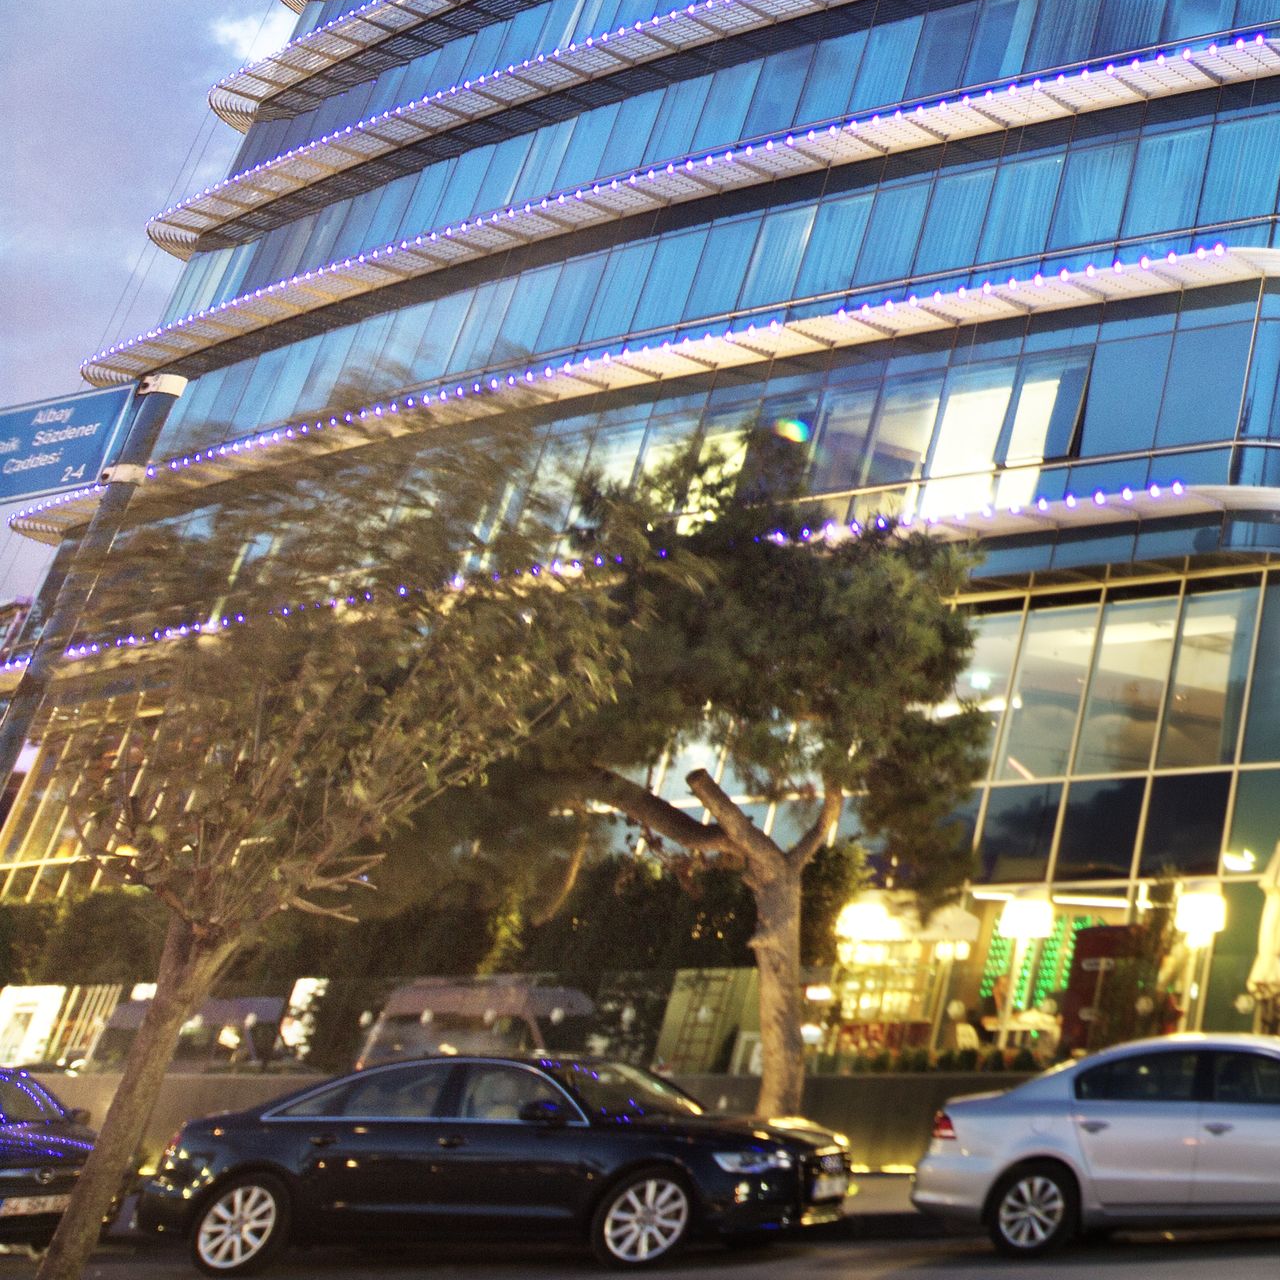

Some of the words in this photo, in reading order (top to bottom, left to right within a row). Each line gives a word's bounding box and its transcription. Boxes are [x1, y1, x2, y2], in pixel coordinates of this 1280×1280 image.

[32, 408, 74, 424] Albay
[3, 447, 64, 474] Caddesi
[61, 463, 86, 482] 2-4
